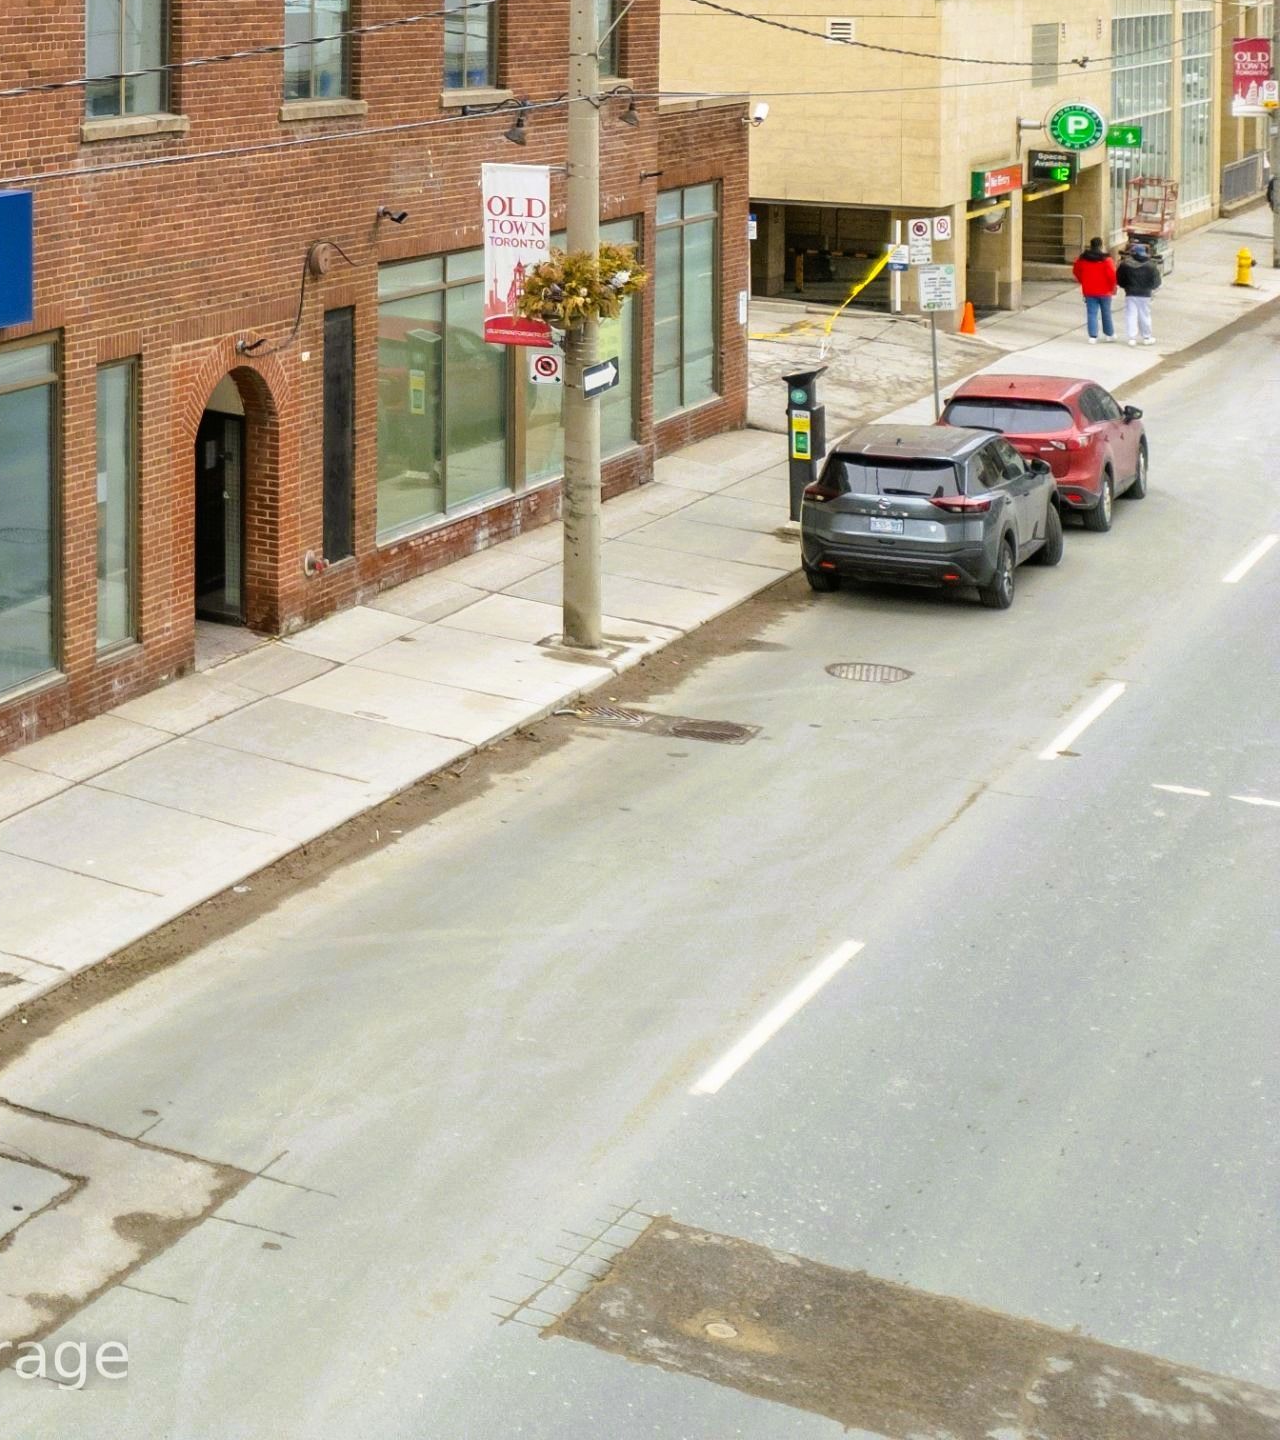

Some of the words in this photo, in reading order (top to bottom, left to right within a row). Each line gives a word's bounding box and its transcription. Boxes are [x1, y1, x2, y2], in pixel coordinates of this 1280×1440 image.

[1235, 51, 1269, 62] OLD
[1067, 116, 1089, 135] P
[1057, 168, 1069, 181] 12
[487, 195, 546, 218] OLD
[488, 219, 546, 236] TOWN
[489, 236, 545, 249] TORONTO
